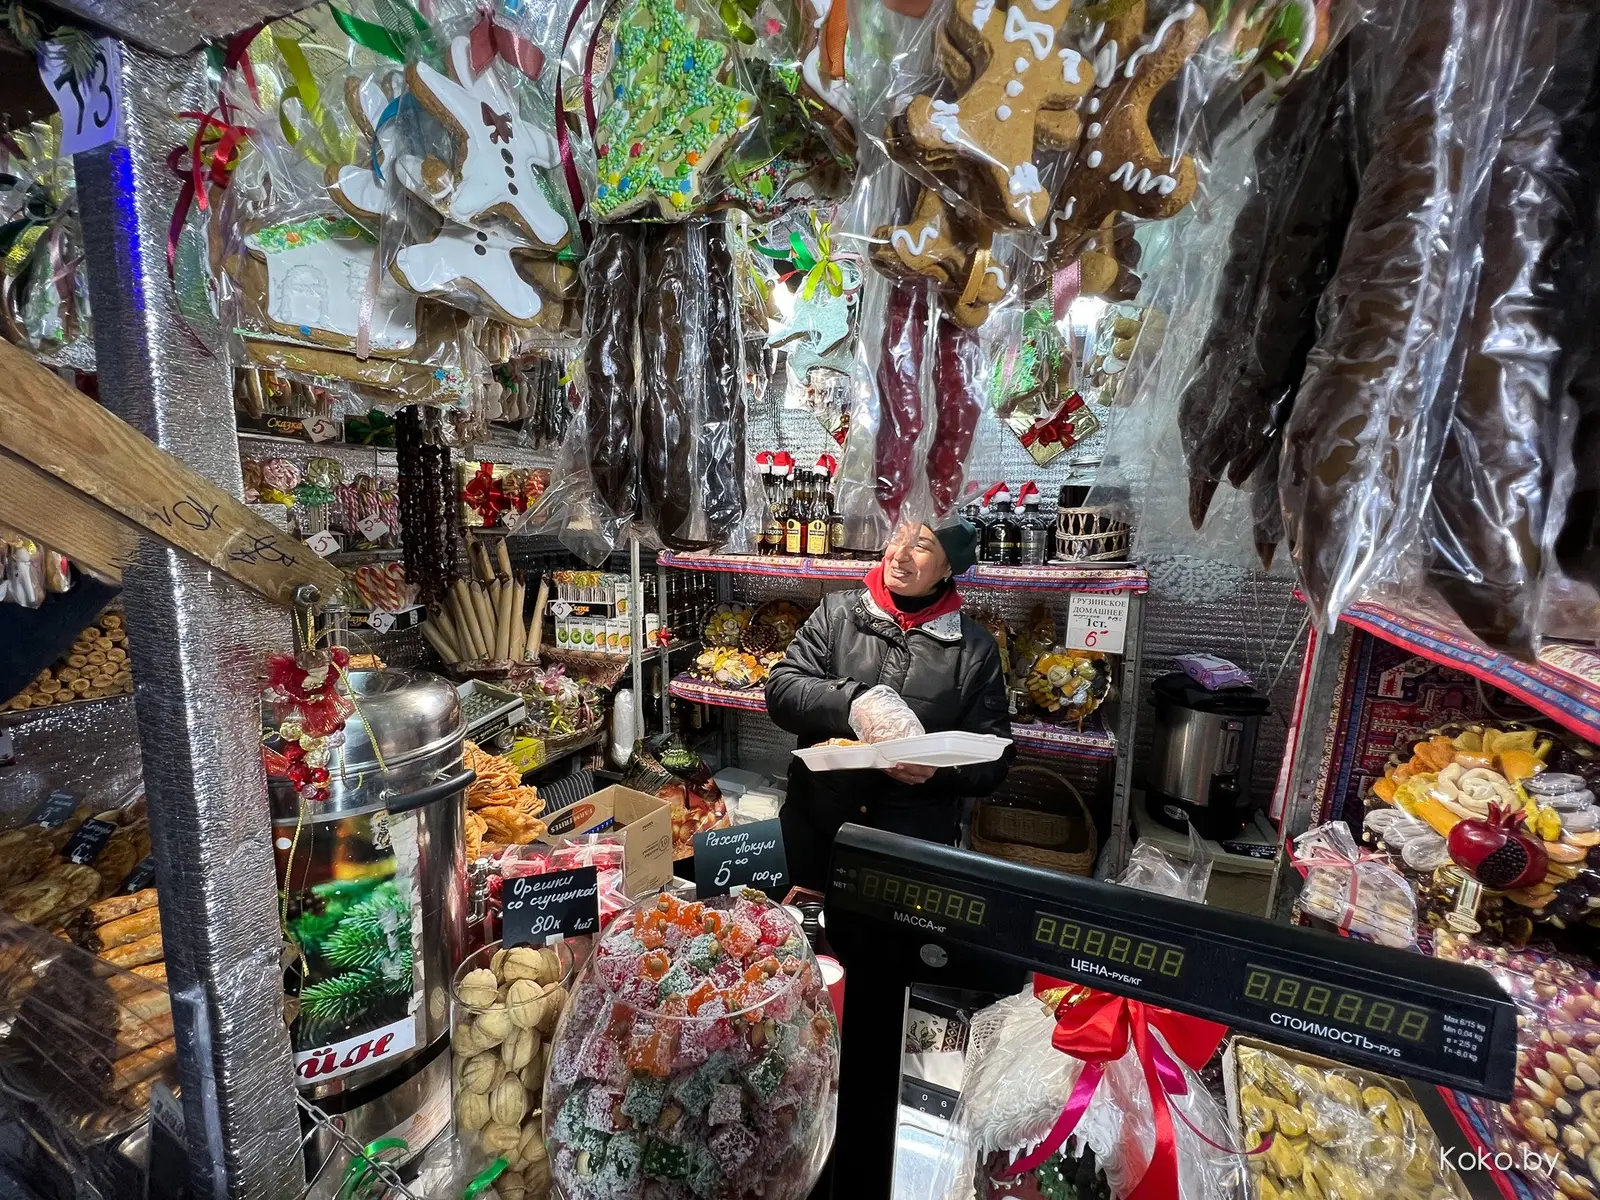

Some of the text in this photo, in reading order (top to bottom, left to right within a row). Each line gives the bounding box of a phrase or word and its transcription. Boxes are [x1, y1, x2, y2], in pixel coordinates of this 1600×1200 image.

[1072, 597, 1127, 607] ГРУЗИНСКОЕ
[1072, 607, 1124, 616] ДОМАШНЕЕ
[550, 817, 573, 834] FRITES
[705, 831, 750, 847] Рахат
[513, 875, 574, 899] Орешки
[833, 880, 847, 889] NET
[507, 883, 598, 911] со сгущенкой
[1443, 1014, 1459, 1024] Max
[1476, 1023, 1486, 1033] kg
[1443, 1024, 1457, 1034] Min
[1474, 1033, 1484, 1043] kg
[1468, 1053, 1478, 1062] kg
